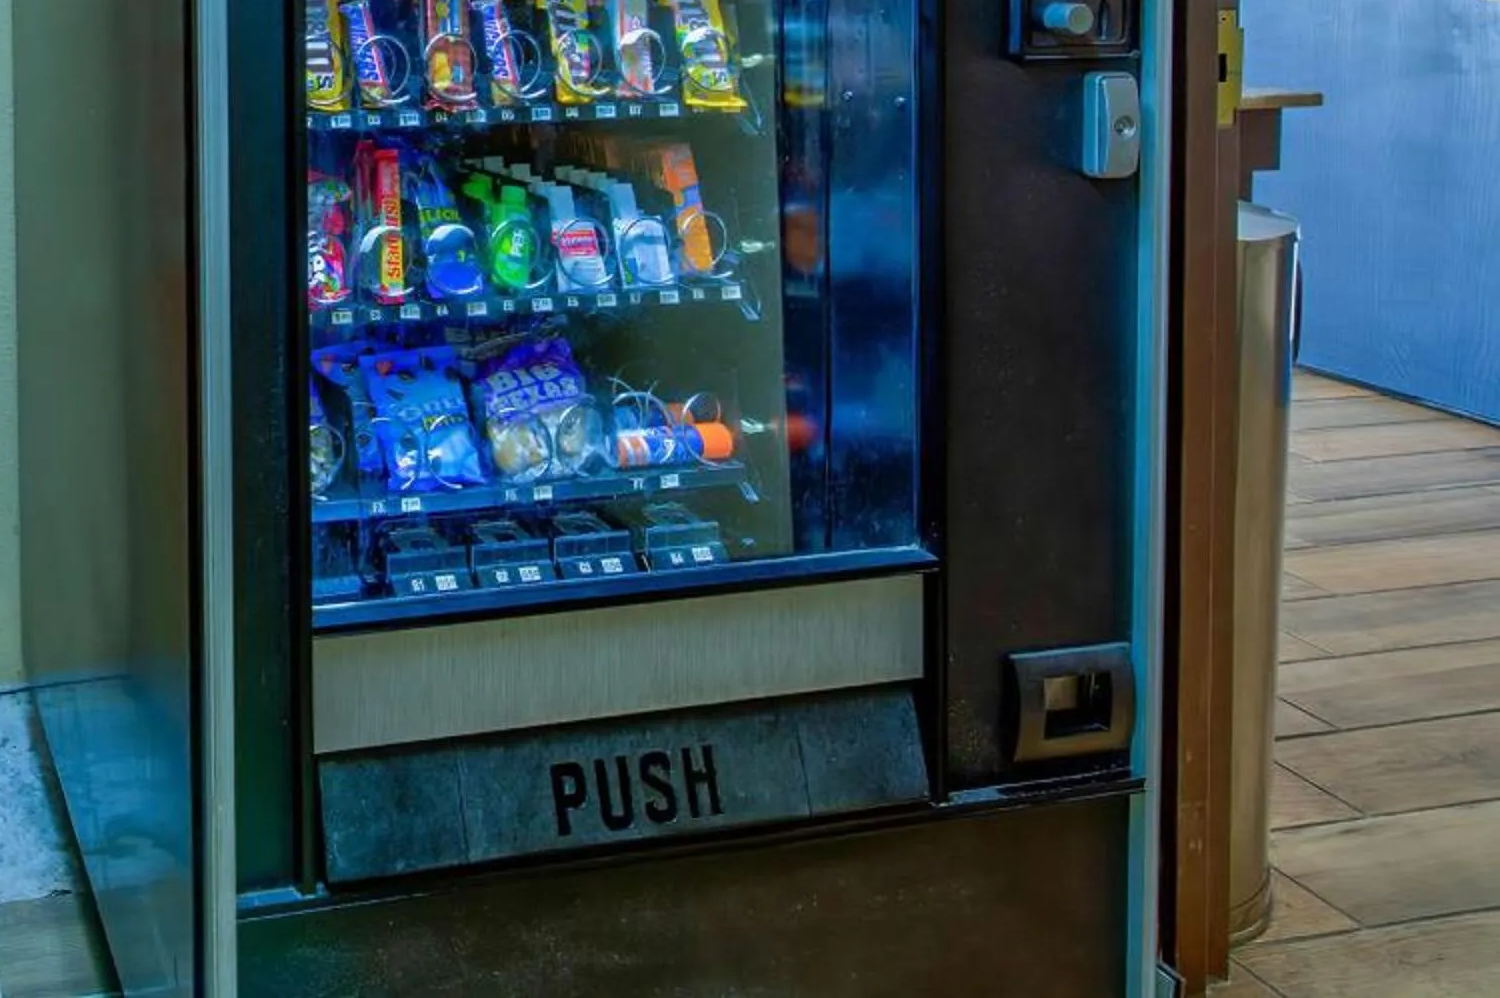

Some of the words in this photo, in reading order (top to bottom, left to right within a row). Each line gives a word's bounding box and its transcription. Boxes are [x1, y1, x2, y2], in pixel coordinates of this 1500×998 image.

[485, 377, 580, 418] TEXAS
[486, 364, 562, 394] BIG
[550, 744, 725, 837] PUSH
